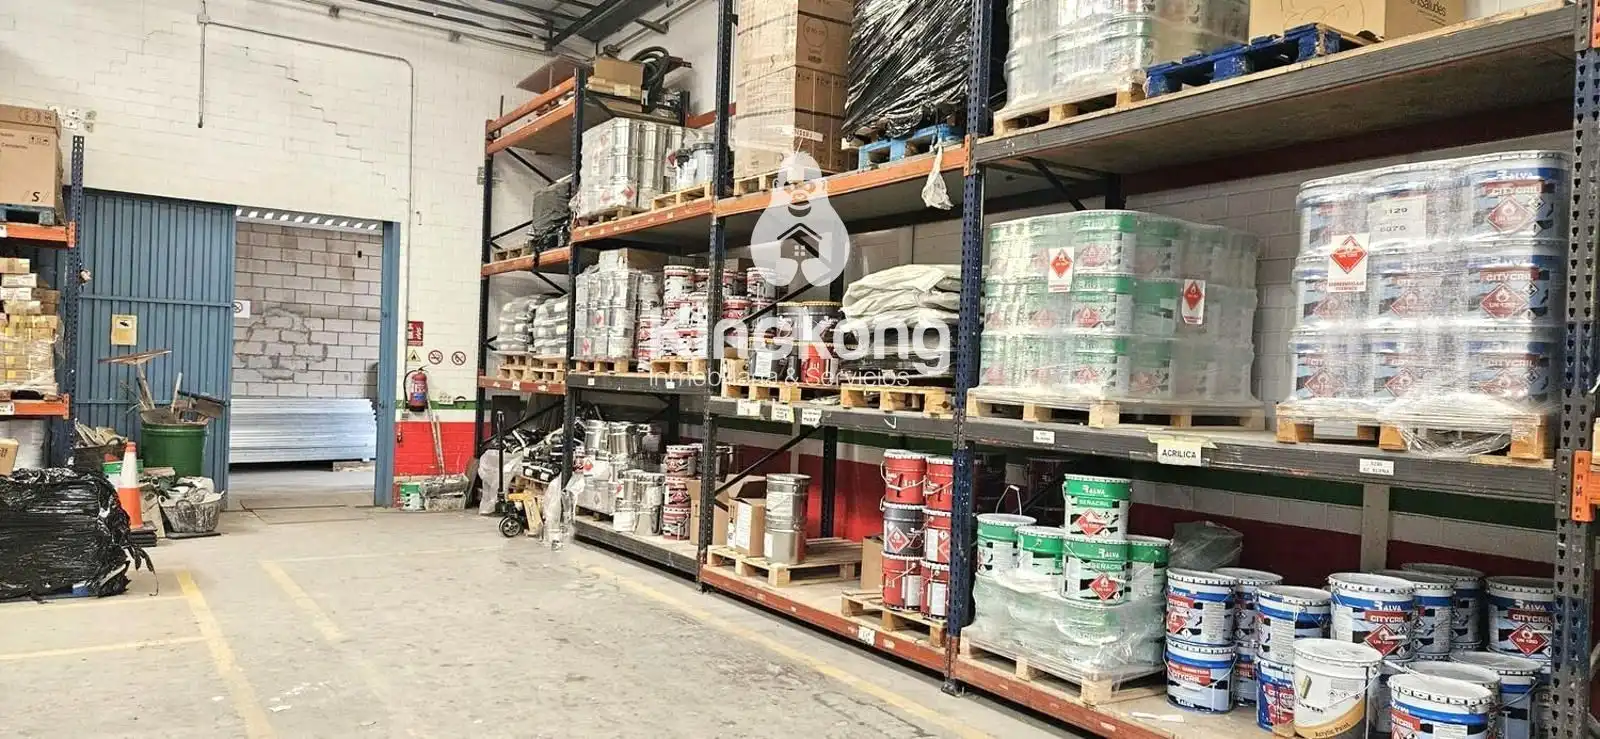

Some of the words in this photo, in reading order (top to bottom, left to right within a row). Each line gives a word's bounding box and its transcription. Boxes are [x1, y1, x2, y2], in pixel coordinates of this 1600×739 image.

[31, 191, 41, 203] S
[1486, 272, 1532, 281] CITYCRIL
[1161, 449, 1197, 459] ACRILICA
[1370, 615, 1405, 623] CITYCRIL
[1512, 613, 1551, 623] CITYCRIL
